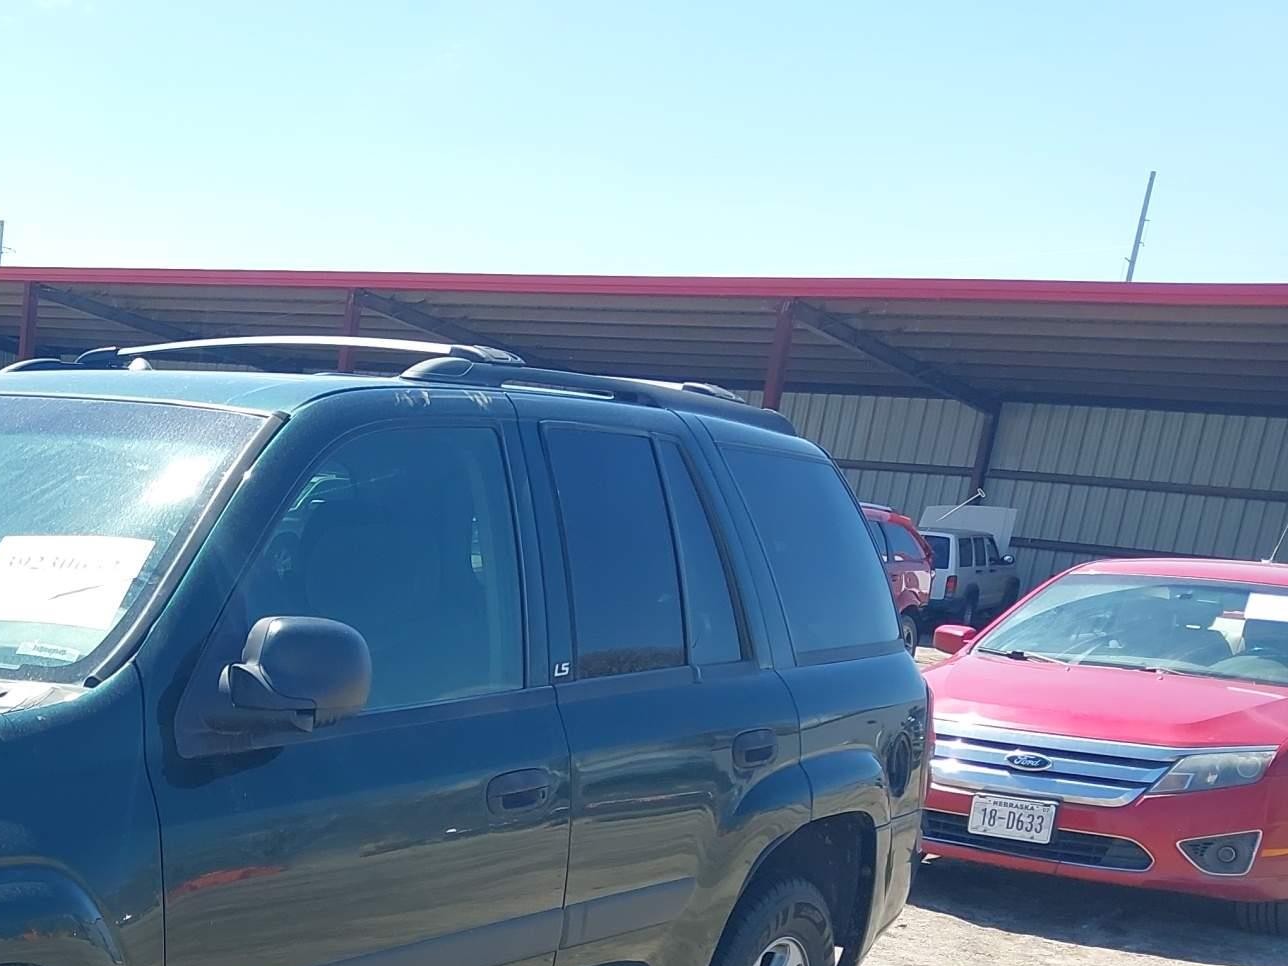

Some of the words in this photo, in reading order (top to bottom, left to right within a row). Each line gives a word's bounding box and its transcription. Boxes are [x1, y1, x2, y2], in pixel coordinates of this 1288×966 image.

[554, 662, 570, 677] LS
[1014, 755, 1040, 767] Ford
[992, 800, 1035, 811] NEBRASKA
[981, 807, 1045, 834] 18-D633
